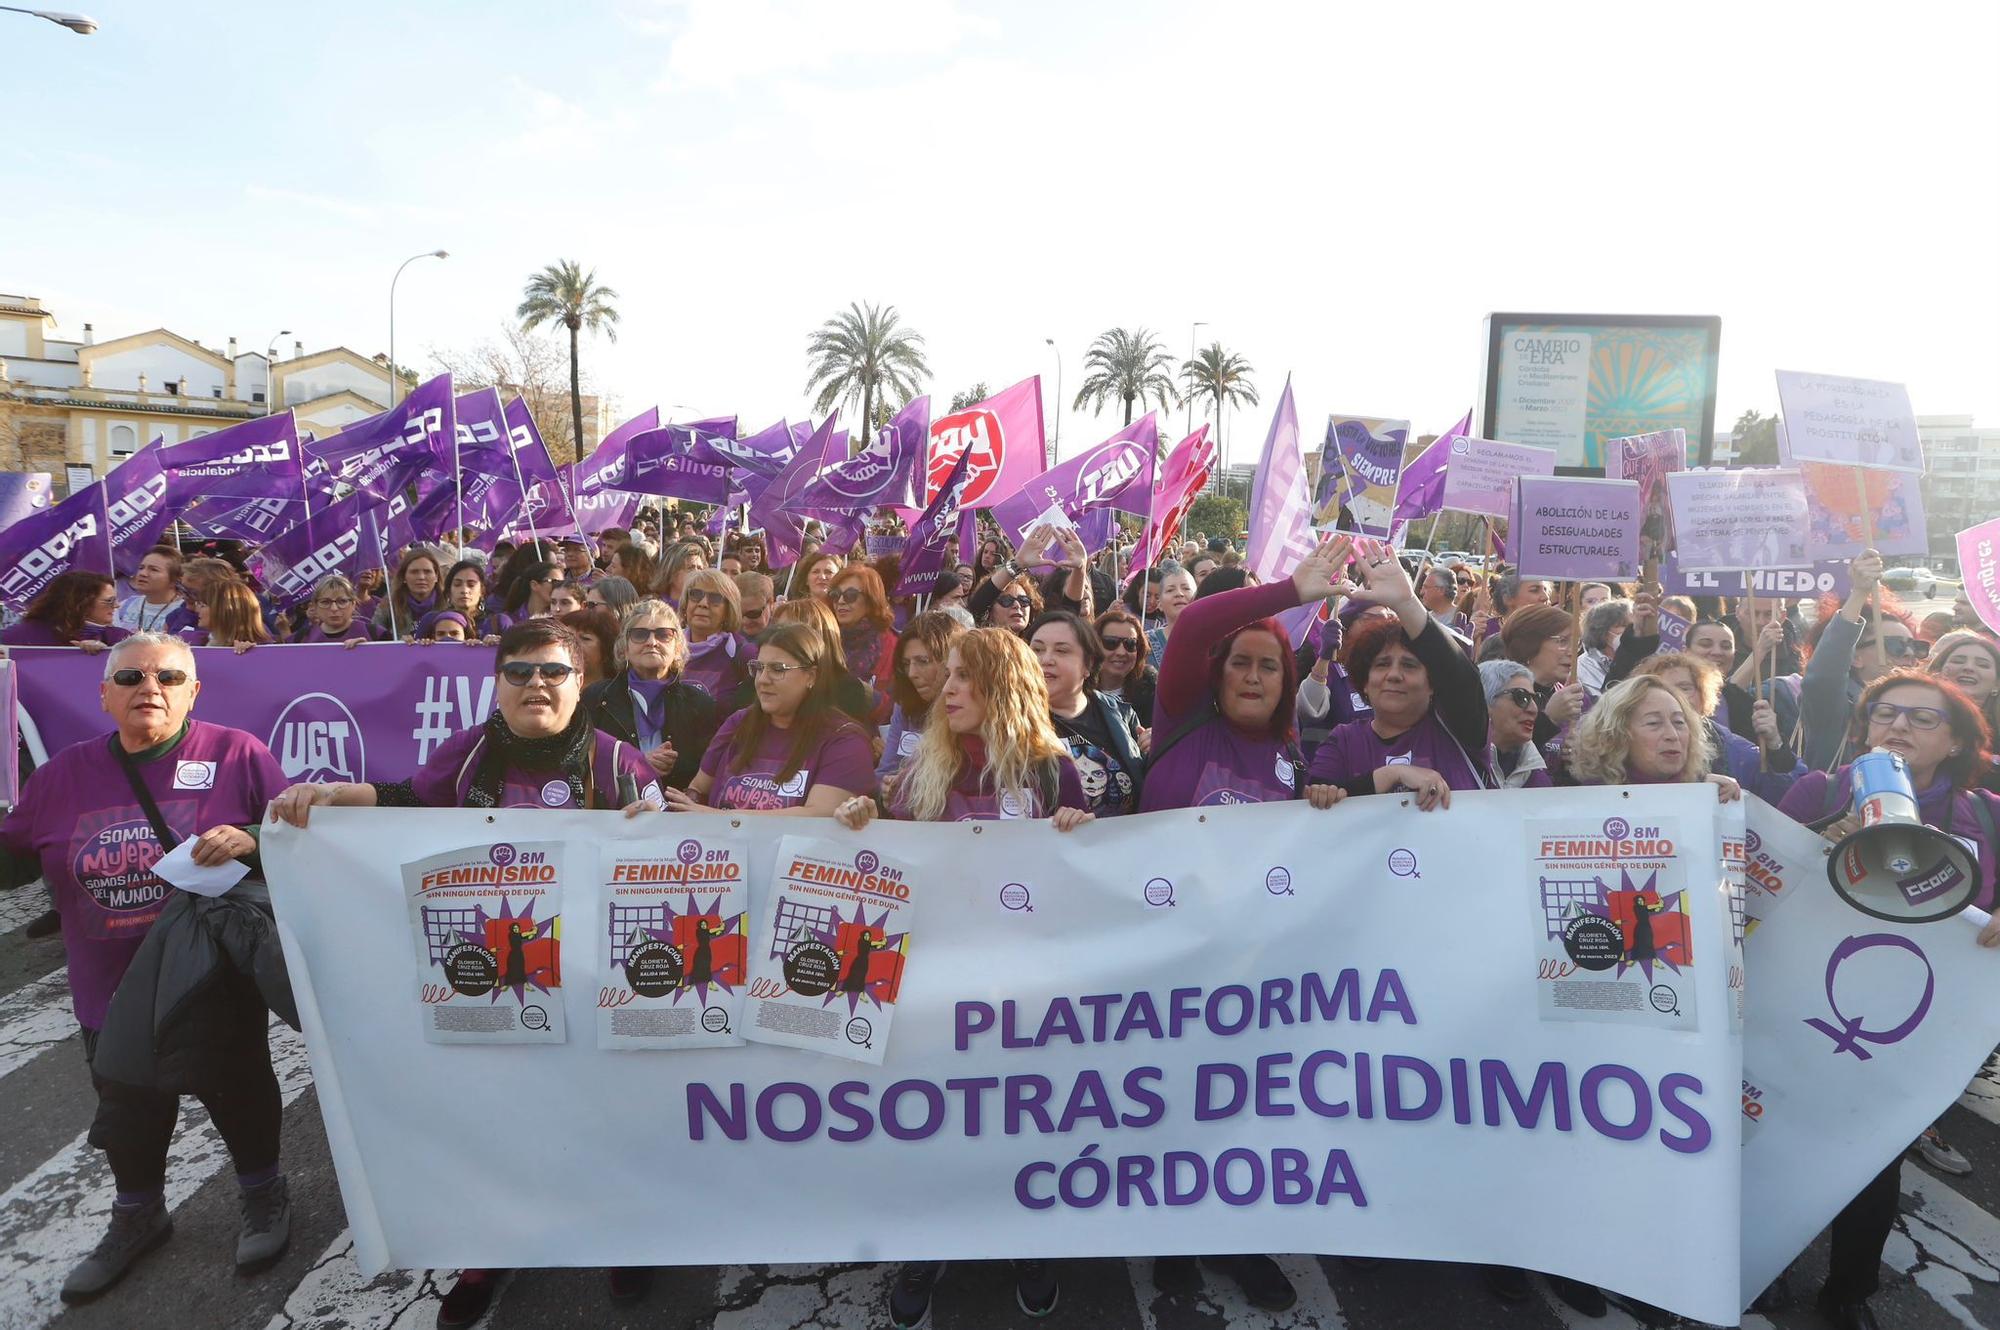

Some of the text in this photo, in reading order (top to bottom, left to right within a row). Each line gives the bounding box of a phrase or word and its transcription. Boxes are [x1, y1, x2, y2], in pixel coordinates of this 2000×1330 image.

[1514, 339, 1581, 353] CAMBIO
[1529, 352, 1565, 365] ERA
[1524, 405, 1549, 413] Marzo
[1351, 452, 1396, 486] SIEMPRE
[1536, 506, 1629, 521] ABOLICIÓN DE LAS
[1541, 526, 1623, 538] DESIGUALDADES
[1539, 544, 1623, 557] ESTRUCTURALES.
[1686, 571, 1835, 592] EL MIEDO
[281, 721, 351, 778] UGT
[1634, 827, 1659, 838] 8M
[520, 852, 545, 864] 8M
[705, 850, 730, 862] 8M
[1540, 839, 1672, 861] FEMINISMO
[613, 863, 739, 885] FEMINISMO
[880, 866, 903, 881] 8M
[1756, 853, 1784, 874] 8M
[85, 875, 126, 889] SOMOS
[421, 865, 555, 890] FEMINISMO
[788, 861, 910, 899] FEMINISMO
[1906, 868, 1951, 897] CCOO
[93, 885, 164, 908] DEL MUNDO
[426, 891, 441, 899] SIN
[478, 888, 510, 897] GÉNERO
[663, 886, 696, 894] GÉNERO
[788, 883, 802, 892] SIN
[835, 891, 867, 903] GÉNERO
[868, 898, 878, 906] DE
[879, 900, 899, 911] DUDA
[1566, 916, 1623, 940] MANIFESTACIÓN
[446, 945, 497, 968] MANIFESTACIÓN
[628, 942, 683, 968] MANIFESTACIÓN
[787, 943, 840, 970] MANIFESTACIÓN
[954, 967, 1418, 1052] PLATAFORMA
[686, 1049, 1712, 1154] NOSOTRAS DECIDIMOS
[1014, 1143, 1367, 1209] CÓRDOBA
